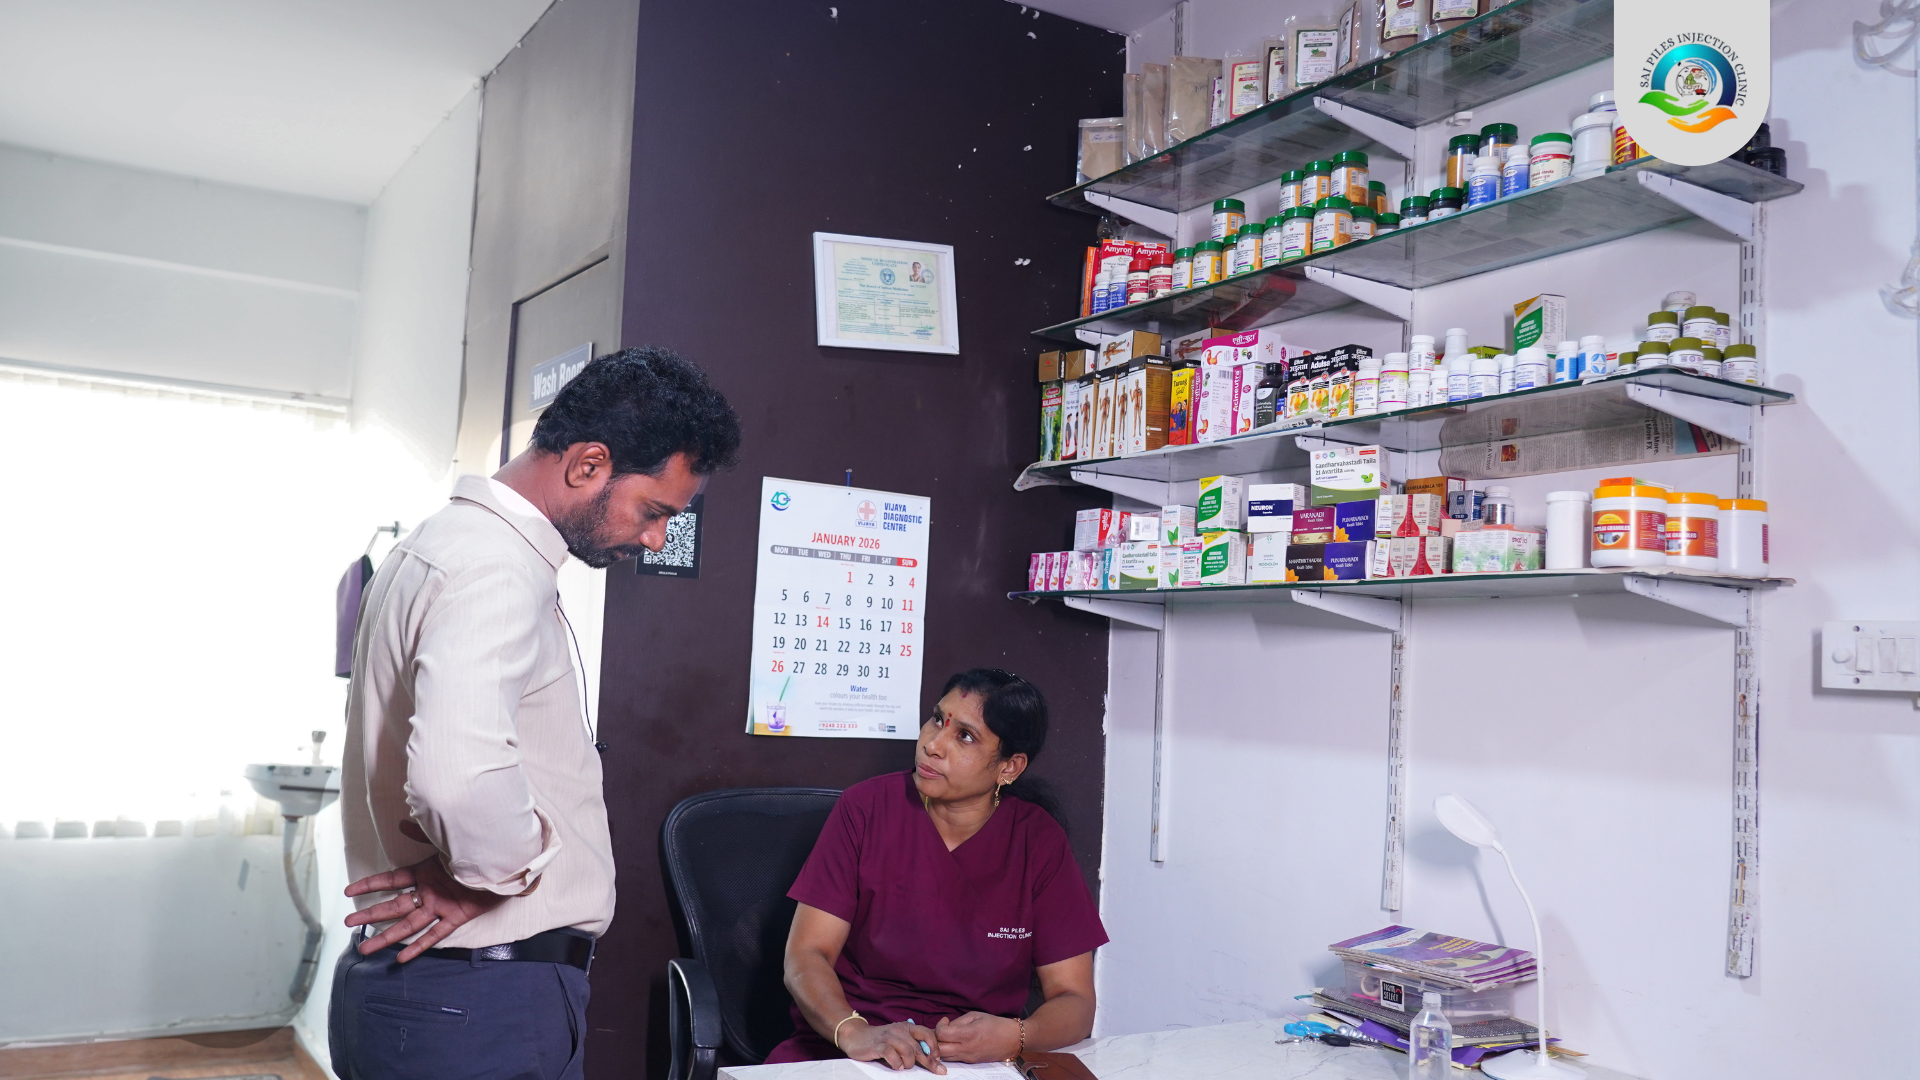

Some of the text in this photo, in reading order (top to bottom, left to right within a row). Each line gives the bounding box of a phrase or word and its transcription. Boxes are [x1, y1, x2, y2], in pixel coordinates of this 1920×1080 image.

[1104, 246, 1132, 254] Amyron
[532, 368, 557, 401] Wash
[884, 502, 907, 513] VIJAYA
[883, 512, 922, 524] DIAGNOSTIC
[883, 522, 906, 532] CENTRE
[811, 532, 880, 549] JANUARY 2026
[774, 546, 789, 554] MON
[818, 551, 831, 559] WED
[840, 553, 851, 561] THU
[861, 555, 870, 563] FRI
[848, 572, 914, 588] 1 2 3 4
[782, 589, 913, 611] 5 6 7 8 9 10 11
[774, 613, 912, 634] 12 13 14 15 16 17 18
[773, 637, 911, 656] 19 20 21 22 23 24 25
[772, 660, 889, 678] 26 27 28 29 30 31
[1383, 991, 1399, 1002] SELECT
